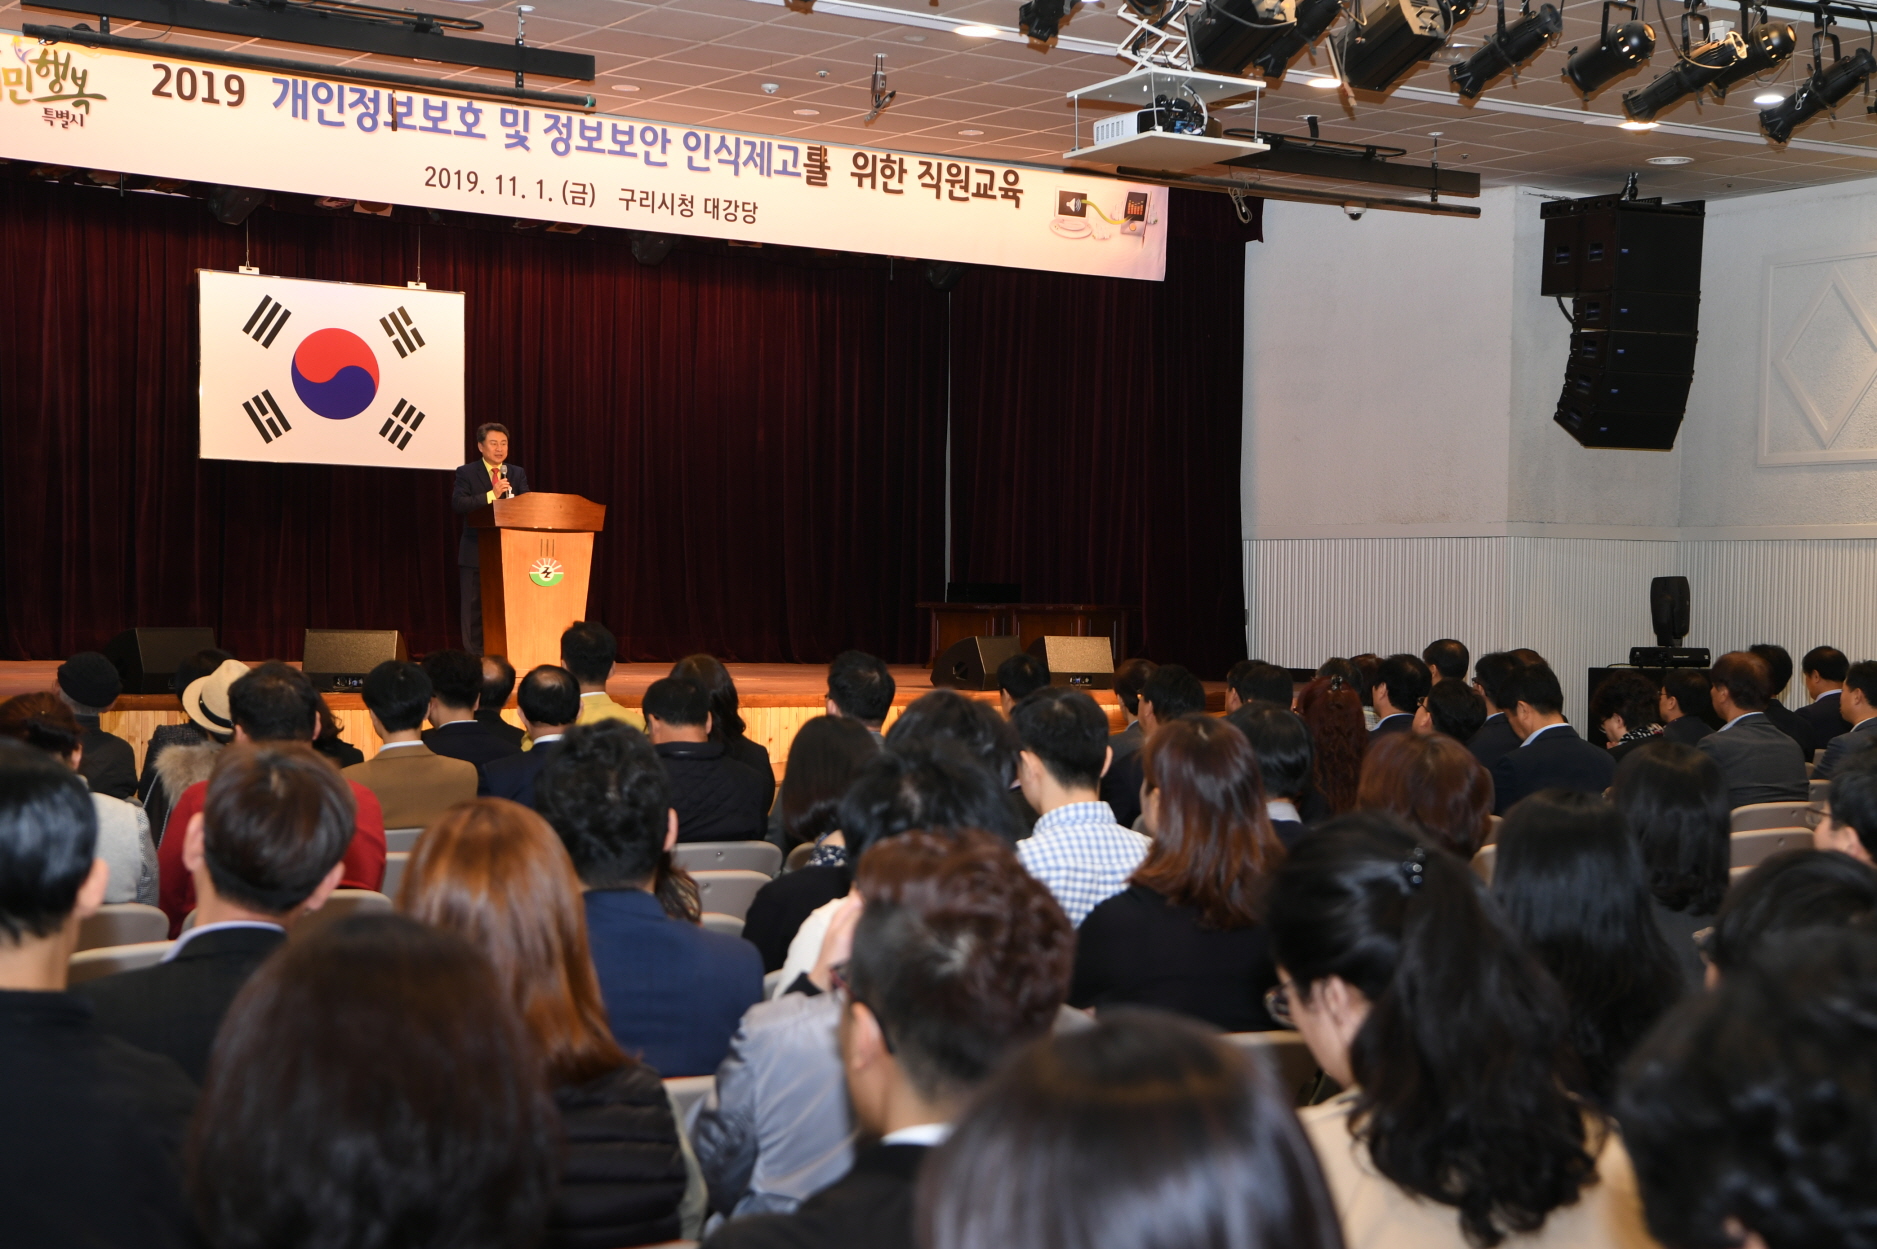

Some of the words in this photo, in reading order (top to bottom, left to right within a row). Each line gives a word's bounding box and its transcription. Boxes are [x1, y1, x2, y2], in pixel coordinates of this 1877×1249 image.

[0, 47, 107, 115] 민행복
[42, 106, 84, 129] 특별시
[152, 64, 245, 107] 2019
[272, 77, 486, 139] 개인정보보호
[500, 107, 530, 151] 및
[544, 113, 671, 167] 정보보안
[682, 130, 831, 186] 인식제고를
[850, 151, 907, 194] 위한
[917, 160, 1023, 208] 직원교육
[424, 166, 485, 194] 2019.
[495, 174, 526, 199] 11.
[536, 179, 553, 202] 1.
[561, 180, 596, 208] (금)
[618, 187, 695, 218] 구리시청
[703, 197, 758, 224] 대강당
